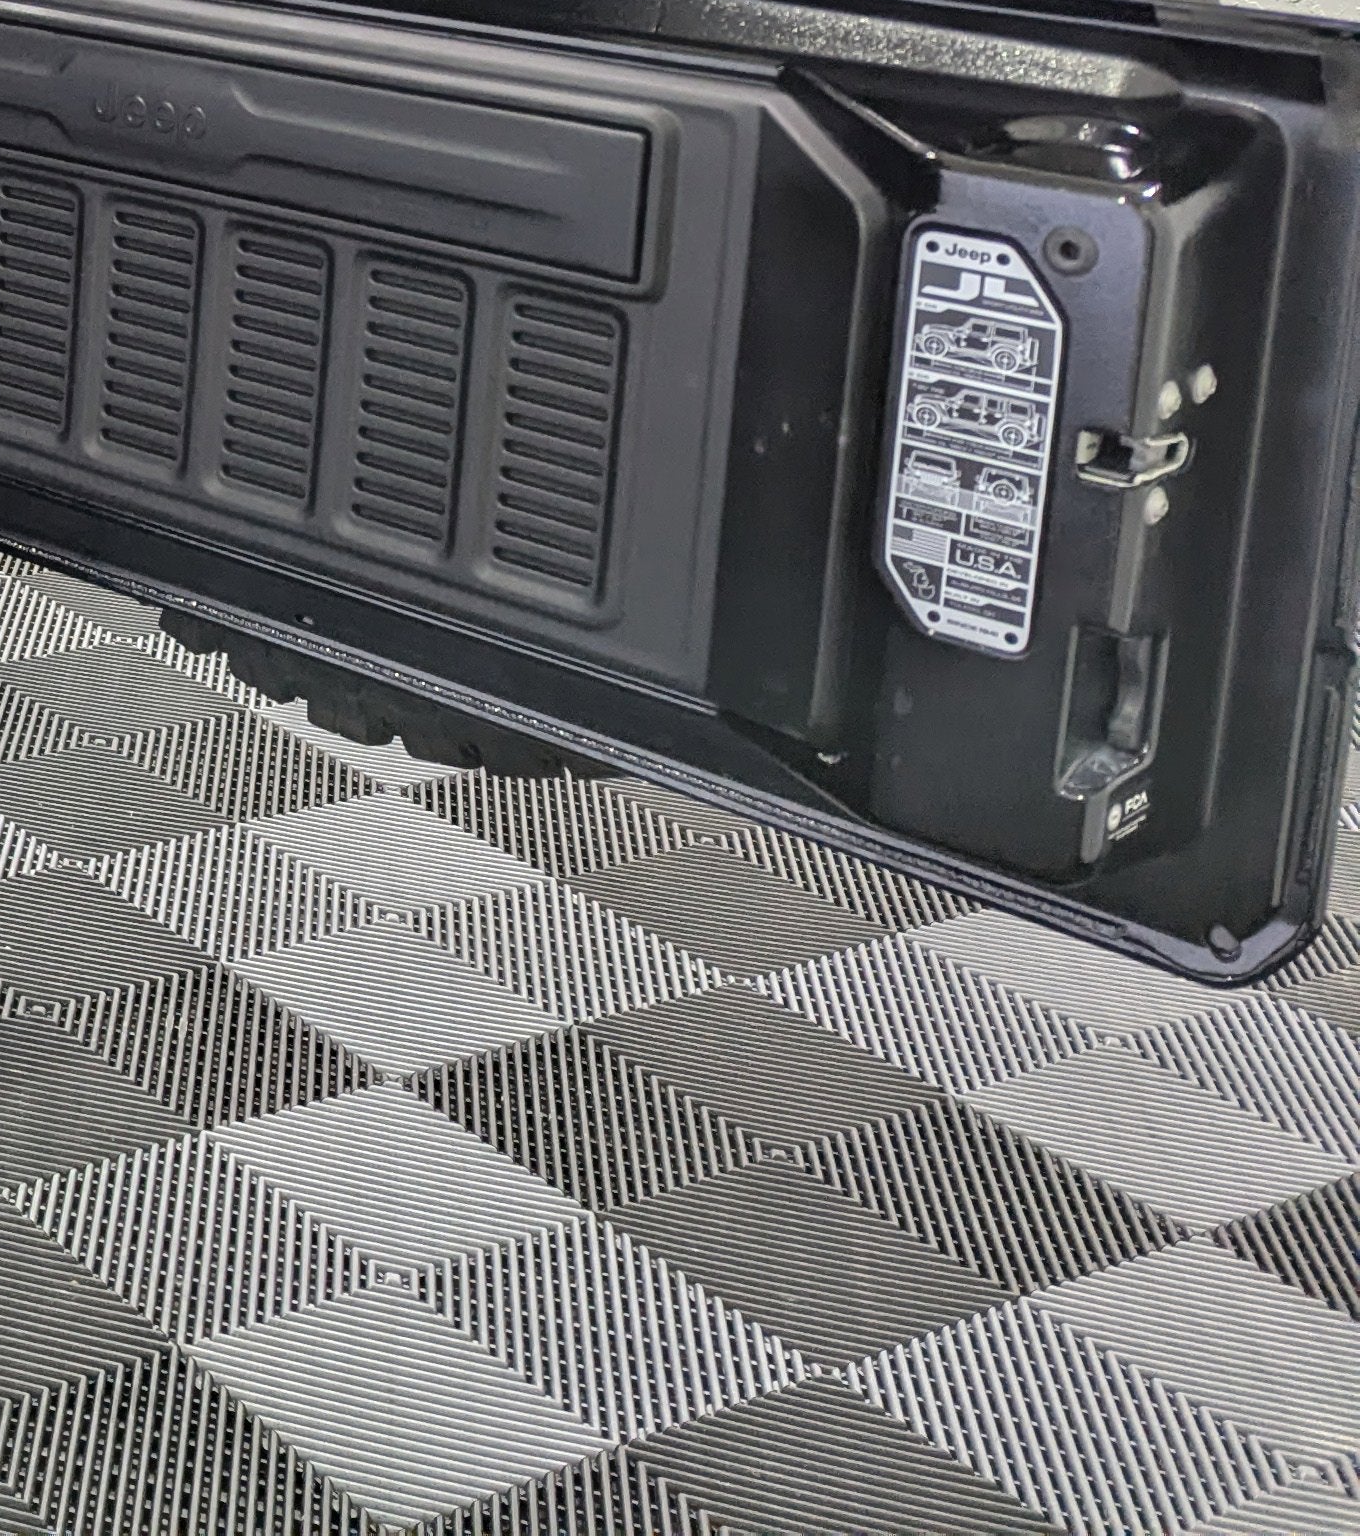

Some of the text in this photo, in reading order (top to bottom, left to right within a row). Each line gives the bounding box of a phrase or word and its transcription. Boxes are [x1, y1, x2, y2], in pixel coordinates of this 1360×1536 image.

[944, 243, 992, 264] Jeep
[920, 270, 1040, 308] JL
[955, 547, 1022, 580] U.S.A.
